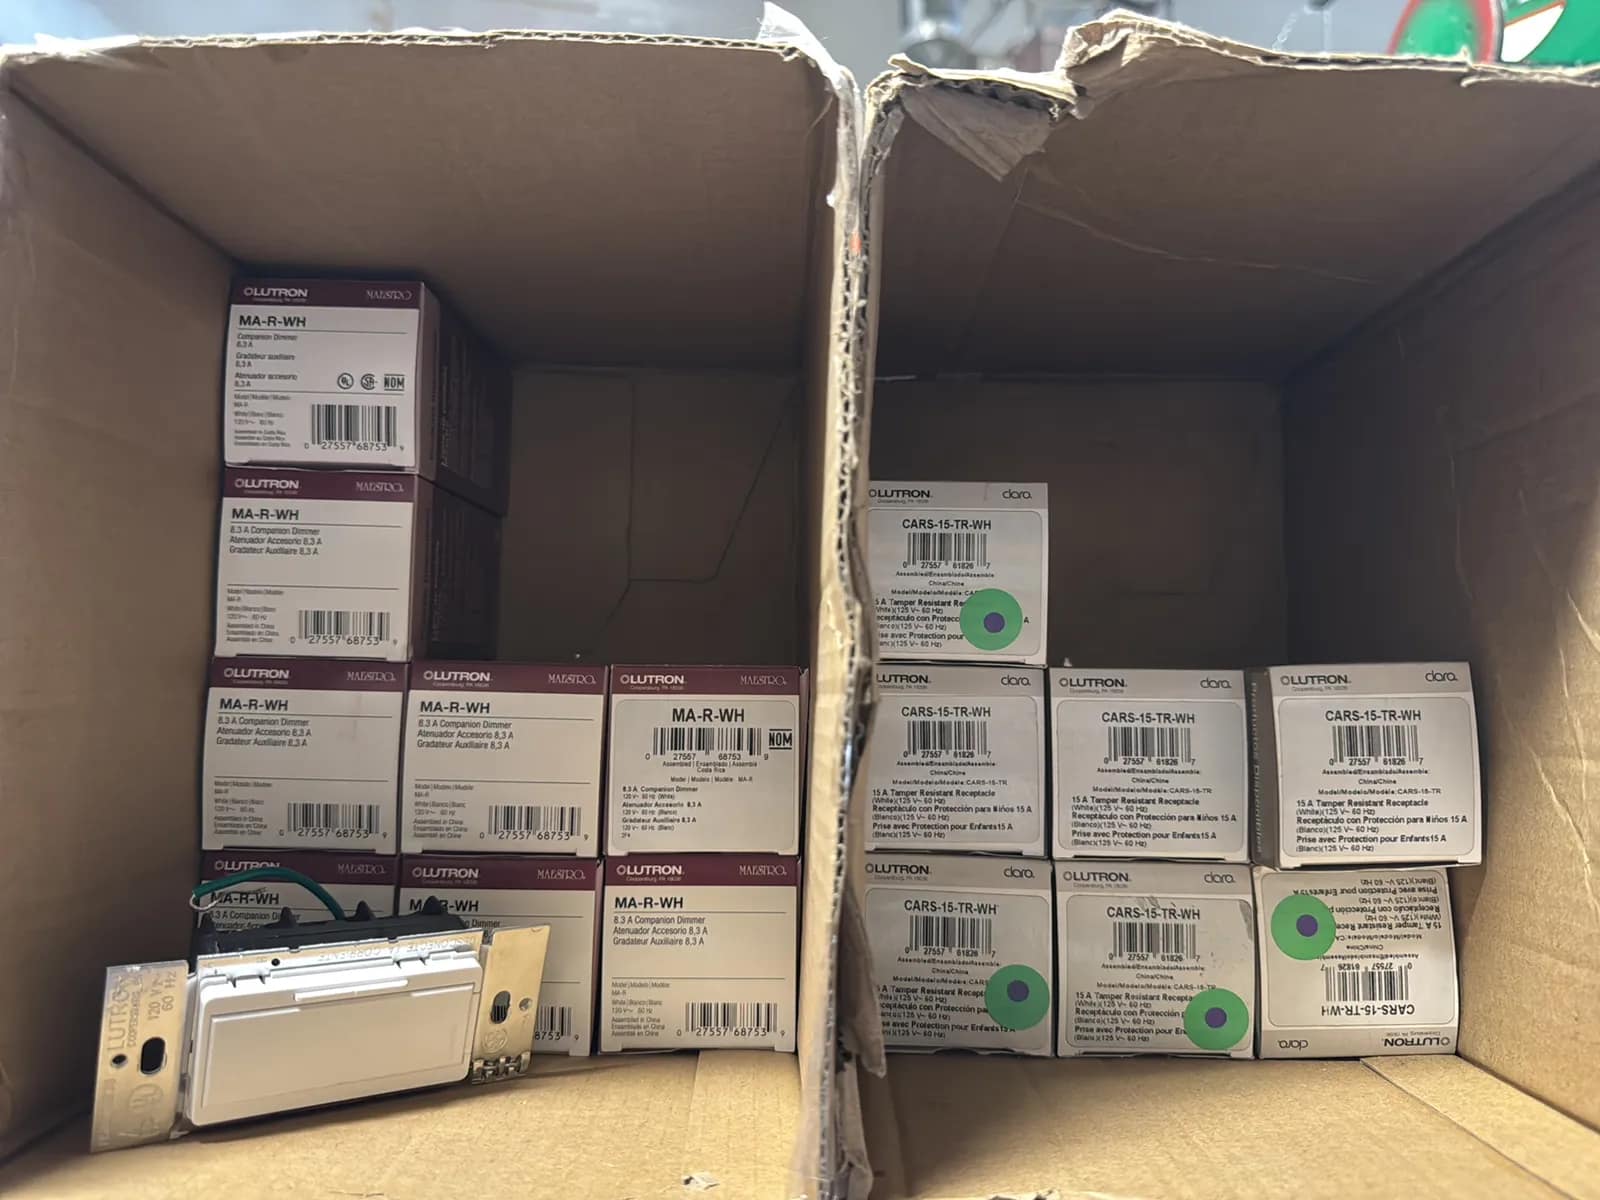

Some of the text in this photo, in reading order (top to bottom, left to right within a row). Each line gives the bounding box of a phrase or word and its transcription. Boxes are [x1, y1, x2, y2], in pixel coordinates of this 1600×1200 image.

[239, 316, 306, 327] MA-R-WH
[384, 374, 405, 391] NOM
[321, 442, 387, 451] 27557 68753
[1003, 489, 1031, 499] clara
[232, 509, 299, 520] MA-R-WH
[903, 519, 991, 529] CARS-15-TR-WH
[309, 636, 379, 645] 27557 68753
[1001, 675, 1030, 685] clara
[1425, 671, 1457, 682] clara
[1200, 677, 1231, 688] clara
[220, 699, 288, 710] MA-R-WH
[420, 702, 490, 713] MA-R-WH
[672, 708, 744, 722] MA-R-WH
[901, 707, 991, 717] CARS-15-TR-WH
[1325, 711, 1421, 721] CARS-15-TR-WH
[1102, 713, 1195, 723] CARS-15-TR-WH
[440, 720, 481, 729] Companion
[769, 729, 792, 749] NOM
[298, 828, 369, 838] 27557 68753
[499, 831, 529, 839] 27557
[537, 832, 570, 840] 68753
[1380, 836, 1397, 844] pour
[1004, 867, 1034, 878] clara
[1204, 872, 1233, 883] clara
[615, 897, 683, 908] MA-R-WH
[905, 900, 996, 914] CARS-15-TR-WH
[1107, 907, 1200, 919] CARS-15-TR-WH
[472, 919, 500, 928] Dimmer
[627, 916, 705, 925] A Companion Dimmer
[1321, 1004, 1415, 1015] CARS-15-TR-WH
[696, 1028, 727, 1036] 27557
[1115, 1027, 1153, 1035] Protection
